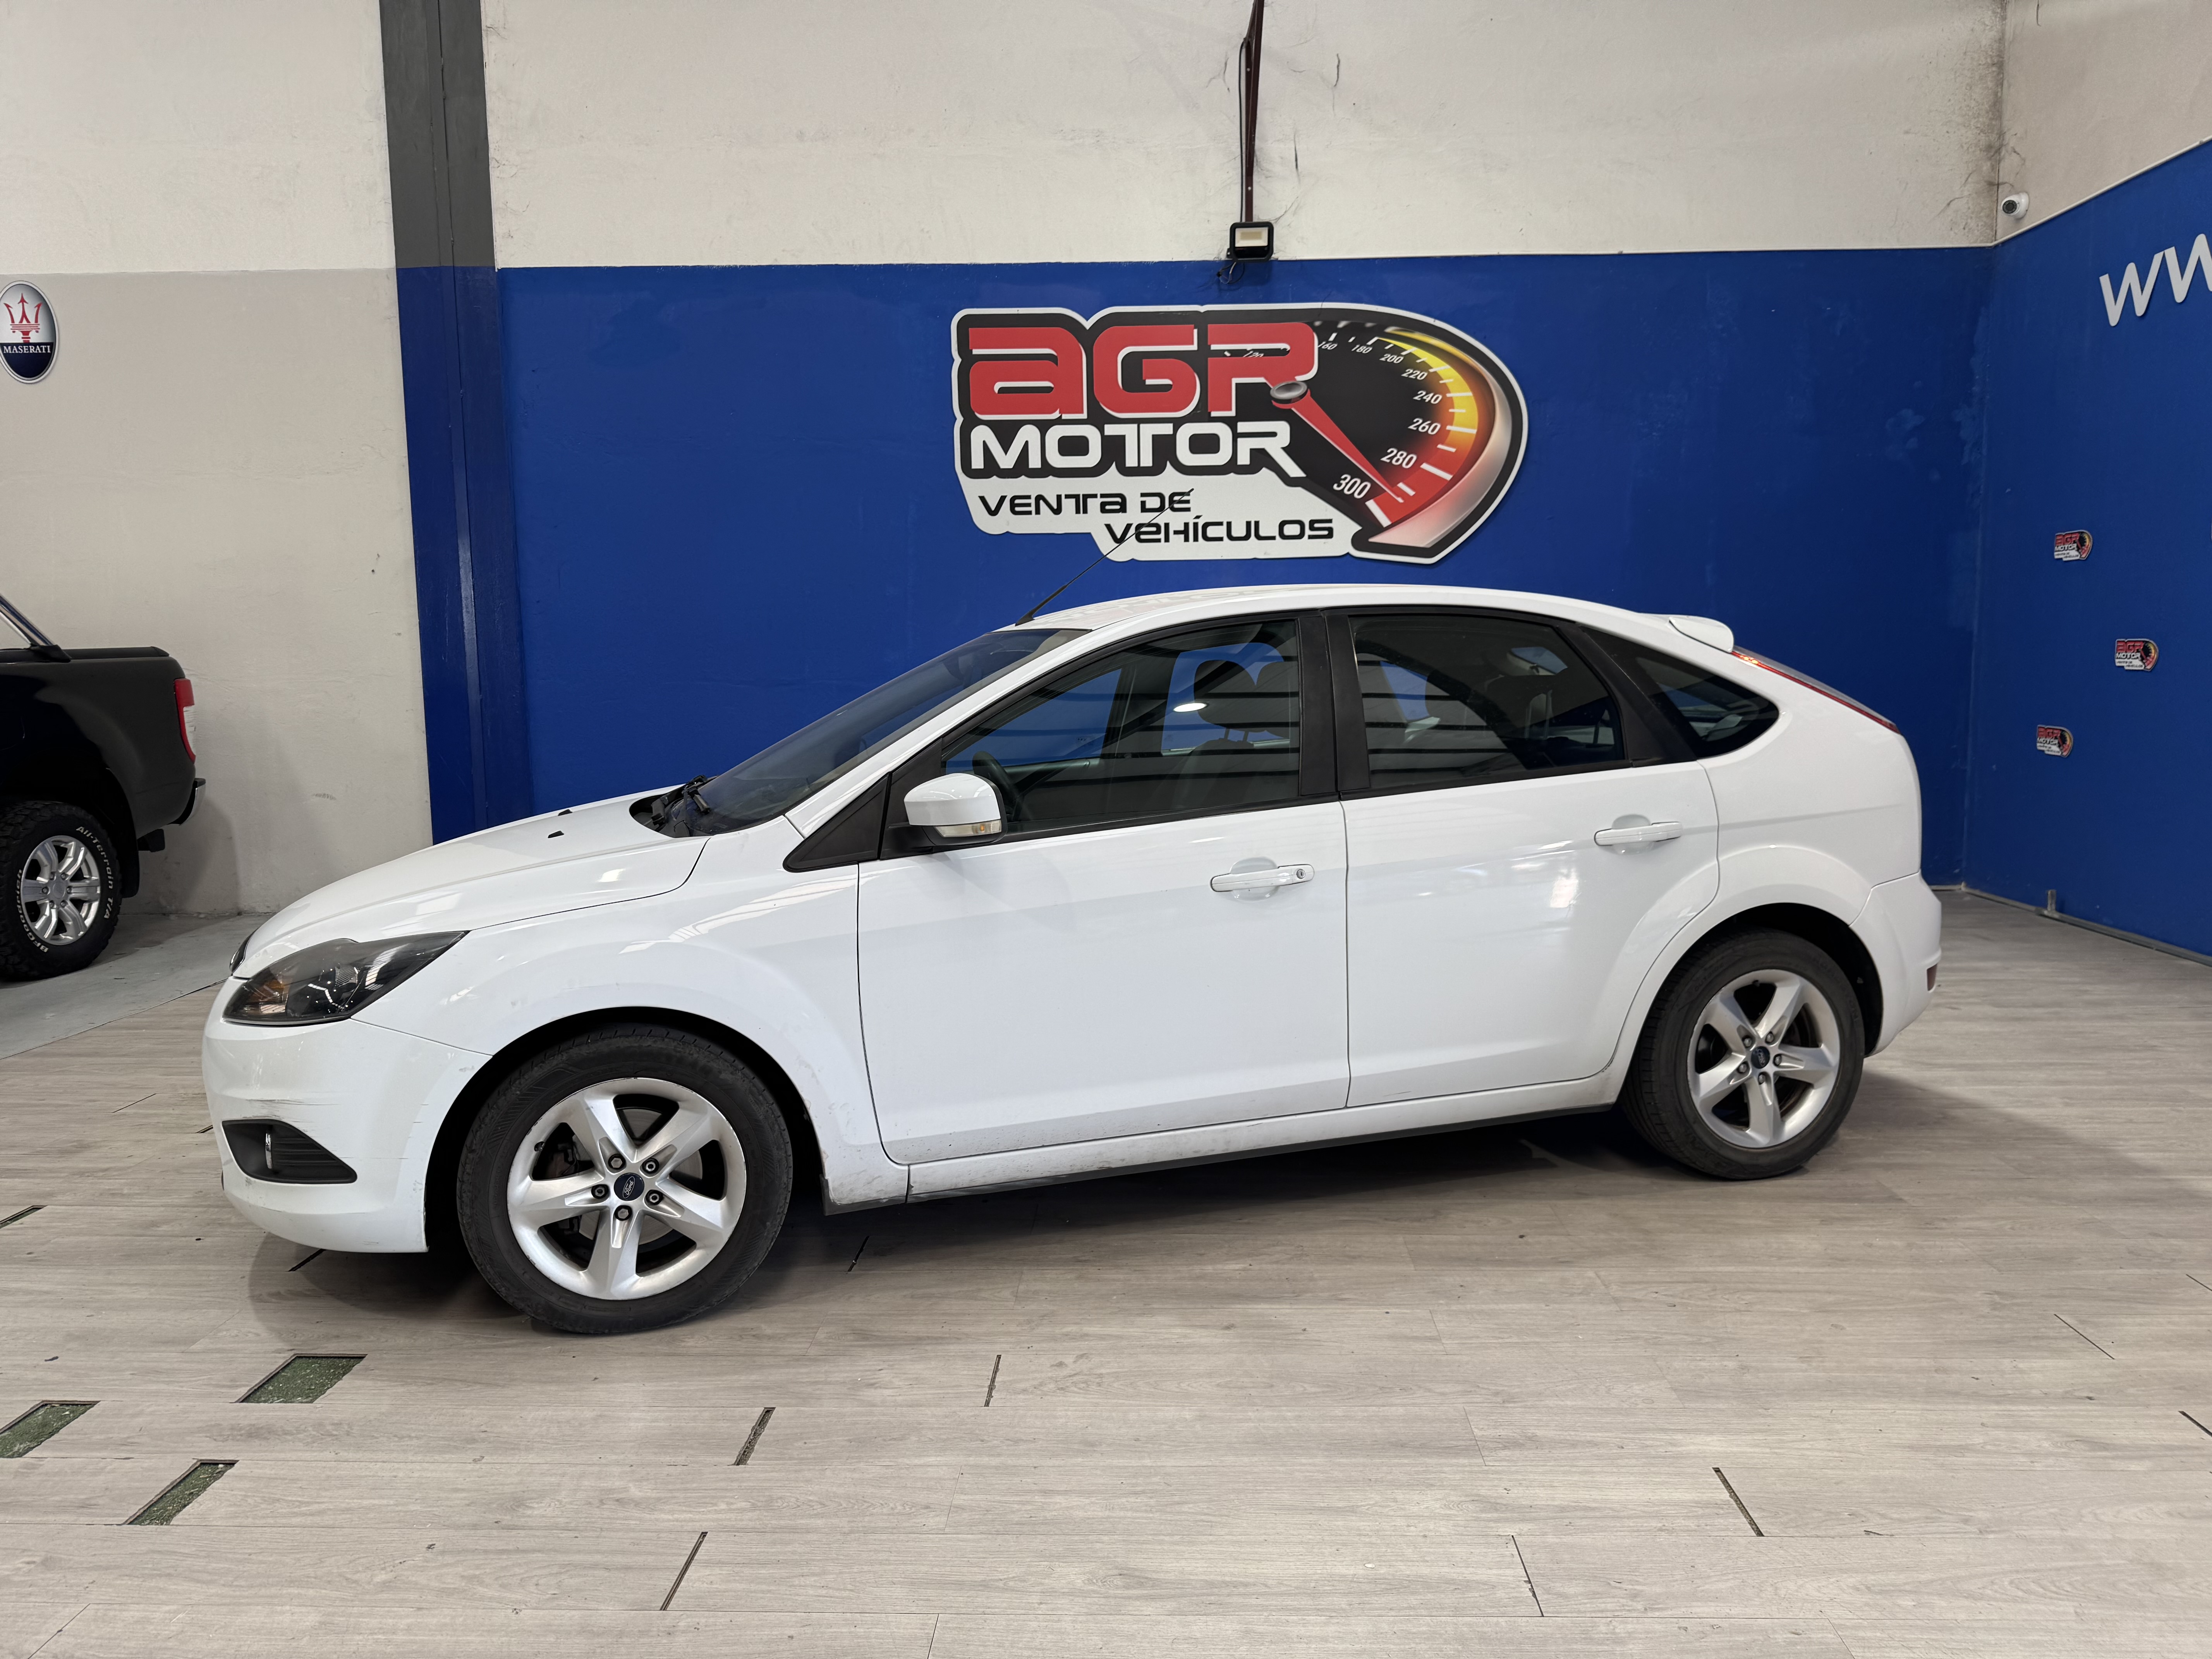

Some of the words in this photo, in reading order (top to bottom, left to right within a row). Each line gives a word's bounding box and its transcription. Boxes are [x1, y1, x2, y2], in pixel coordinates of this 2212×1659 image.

[1317, 341, 1338, 350] 160
[1352, 345, 1372, 354] 180
[1379, 354, 1404, 364] 200
[1401, 369, 1428, 380] 220
[1413, 390, 1443, 404] 240
[1408, 418, 1441, 435] 260
[970, 421, 1307, 477] MOTOR
[1380, 448, 1417, 469] 280
[1333, 474, 1371, 498] 300
[1140, 491, 1191, 513] DE
[76, 826, 113, 889] All-Terrain
[104, 897, 113, 919] T/A
[16, 869, 48, 953] BFGoodrich
[624, 1180, 634, 1195] Ford
